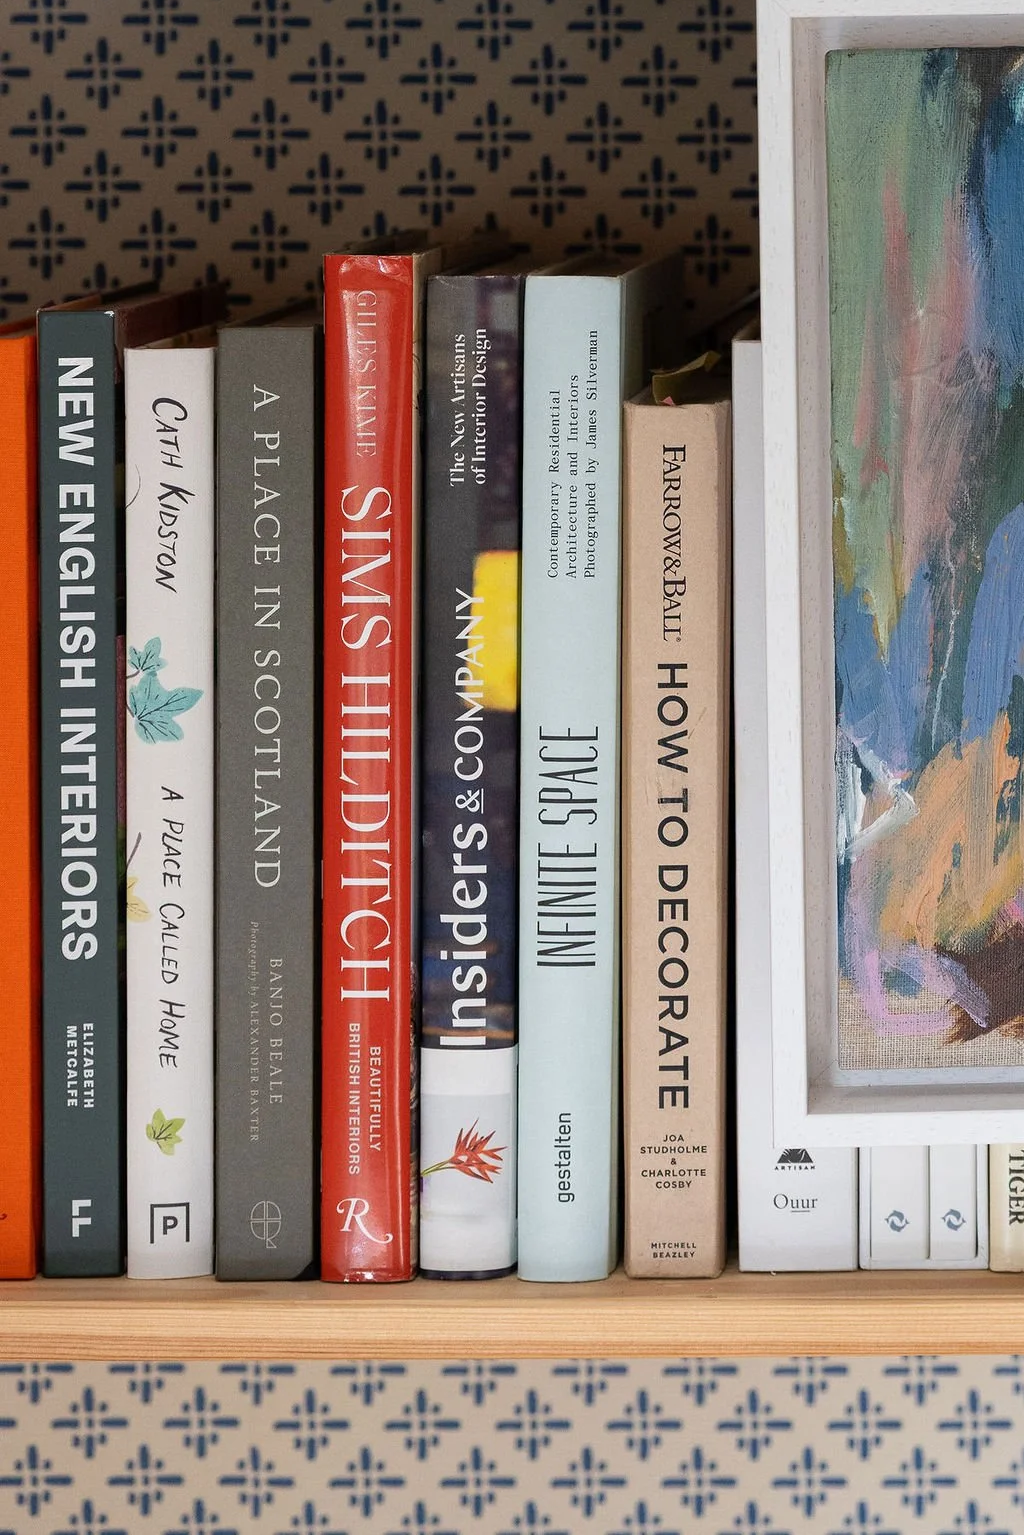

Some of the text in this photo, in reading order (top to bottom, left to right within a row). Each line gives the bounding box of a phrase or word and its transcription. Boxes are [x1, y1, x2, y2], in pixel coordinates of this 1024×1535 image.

[356, 290, 377, 457] GILES KIME
[450, 334, 466, 487] The New Artisans
[471, 328, 491, 485] of Interior Design
[547, 389, 563, 578] Contemporary Residential
[565, 374, 579, 579] Architecture and Interiors
[584, 329, 600, 579] Photographed by James Silverman
[58, 357, 98, 961] NEW ENGLISH INTERIORS
[253, 384, 282, 888] A PLACE IN SCOTLAND
[161, 785, 184, 801] A
[340, 485, 392, 1002] SIMS HILDITCH
[161, 818, 185, 888] PLACE
[439, 588, 488, 1046] Insiders & COMPANY
[537, 725, 599, 967] INFINITE SPACE
[657, 663, 689, 1109] HOW TO DECORATE
[159, 903, 185, 985] CALLED
[67, 1025, 78, 1107] METCALFE
[83, 1022, 95, 1109] ELIZABETH
[247, 921, 260, 1142] Photography by ALEXANDER BAXTER
[269, 958, 283, 1104] BANJO BEALE
[349, 1023, 361, 1175] BRITISH INTERIORS
[369, 1046, 382, 1151] BEAUTIFULLY
[640, 1145, 708, 1155] STUDHOLME
[662, 1134, 685, 1143] JOA
[554, 1112, 575, 1203] gestalten
[641, 1168, 707, 1178] CHARLOTTE
[655, 1180, 692, 1189] COSBY
[670, 1158, 677, 1166] &
[773, 1193, 818, 1211] Ouur
[336, 1197, 393, 1244] R
[651, 1242, 697, 1250] MITCHELL
[652, 1251, 696, 1259] BEAZLEY
